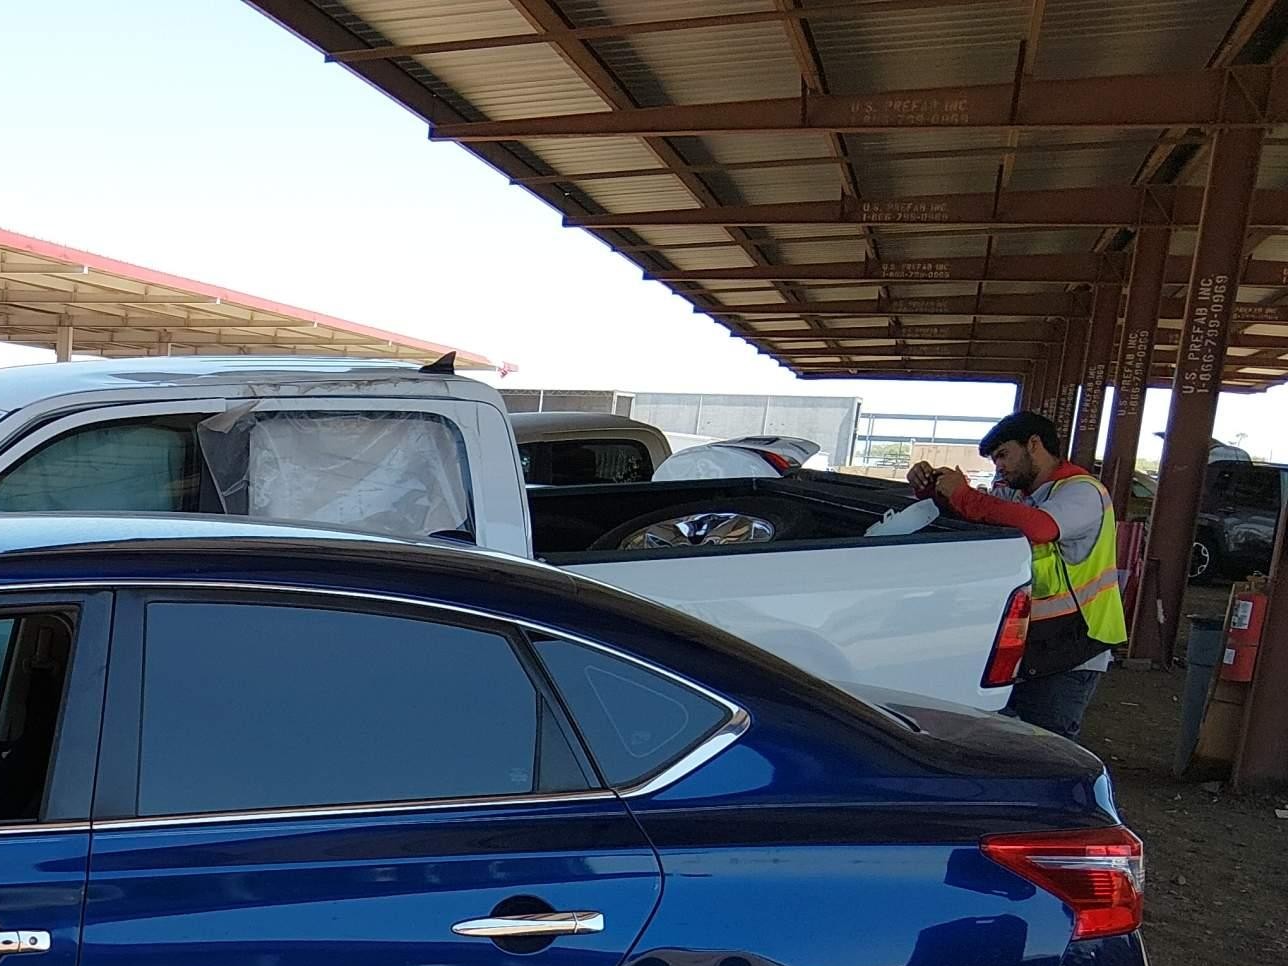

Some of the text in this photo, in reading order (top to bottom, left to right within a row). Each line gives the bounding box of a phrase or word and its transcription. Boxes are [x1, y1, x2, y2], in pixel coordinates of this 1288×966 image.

[1120, 353, 1135, 392] PREFAB
[1182, 273, 1214, 394] U.S. PREFAB INC.
